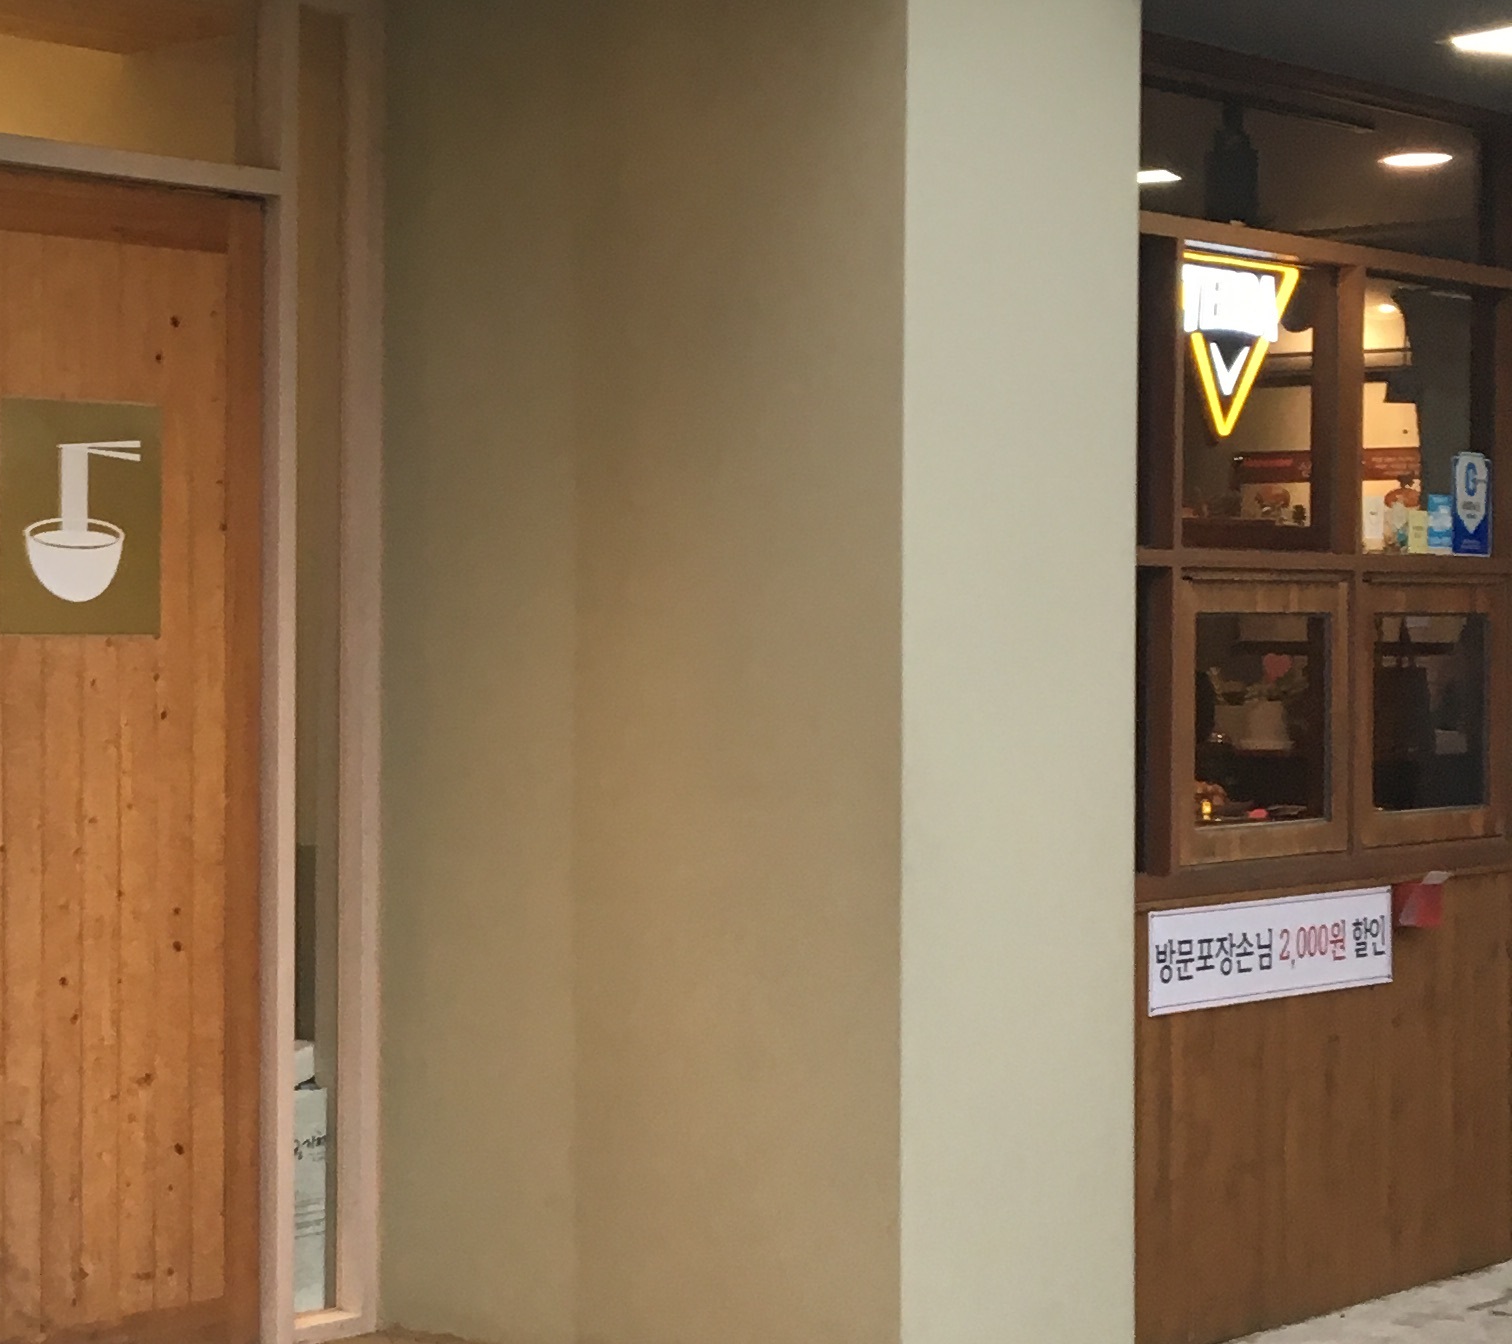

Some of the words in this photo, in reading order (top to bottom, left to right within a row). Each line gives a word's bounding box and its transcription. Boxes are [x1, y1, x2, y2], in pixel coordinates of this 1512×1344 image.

[1155, 928, 1273, 984] 방문포장손님
[1279, 918, 1346, 969] 2,000원
[1352, 914, 1386, 959] 할인
